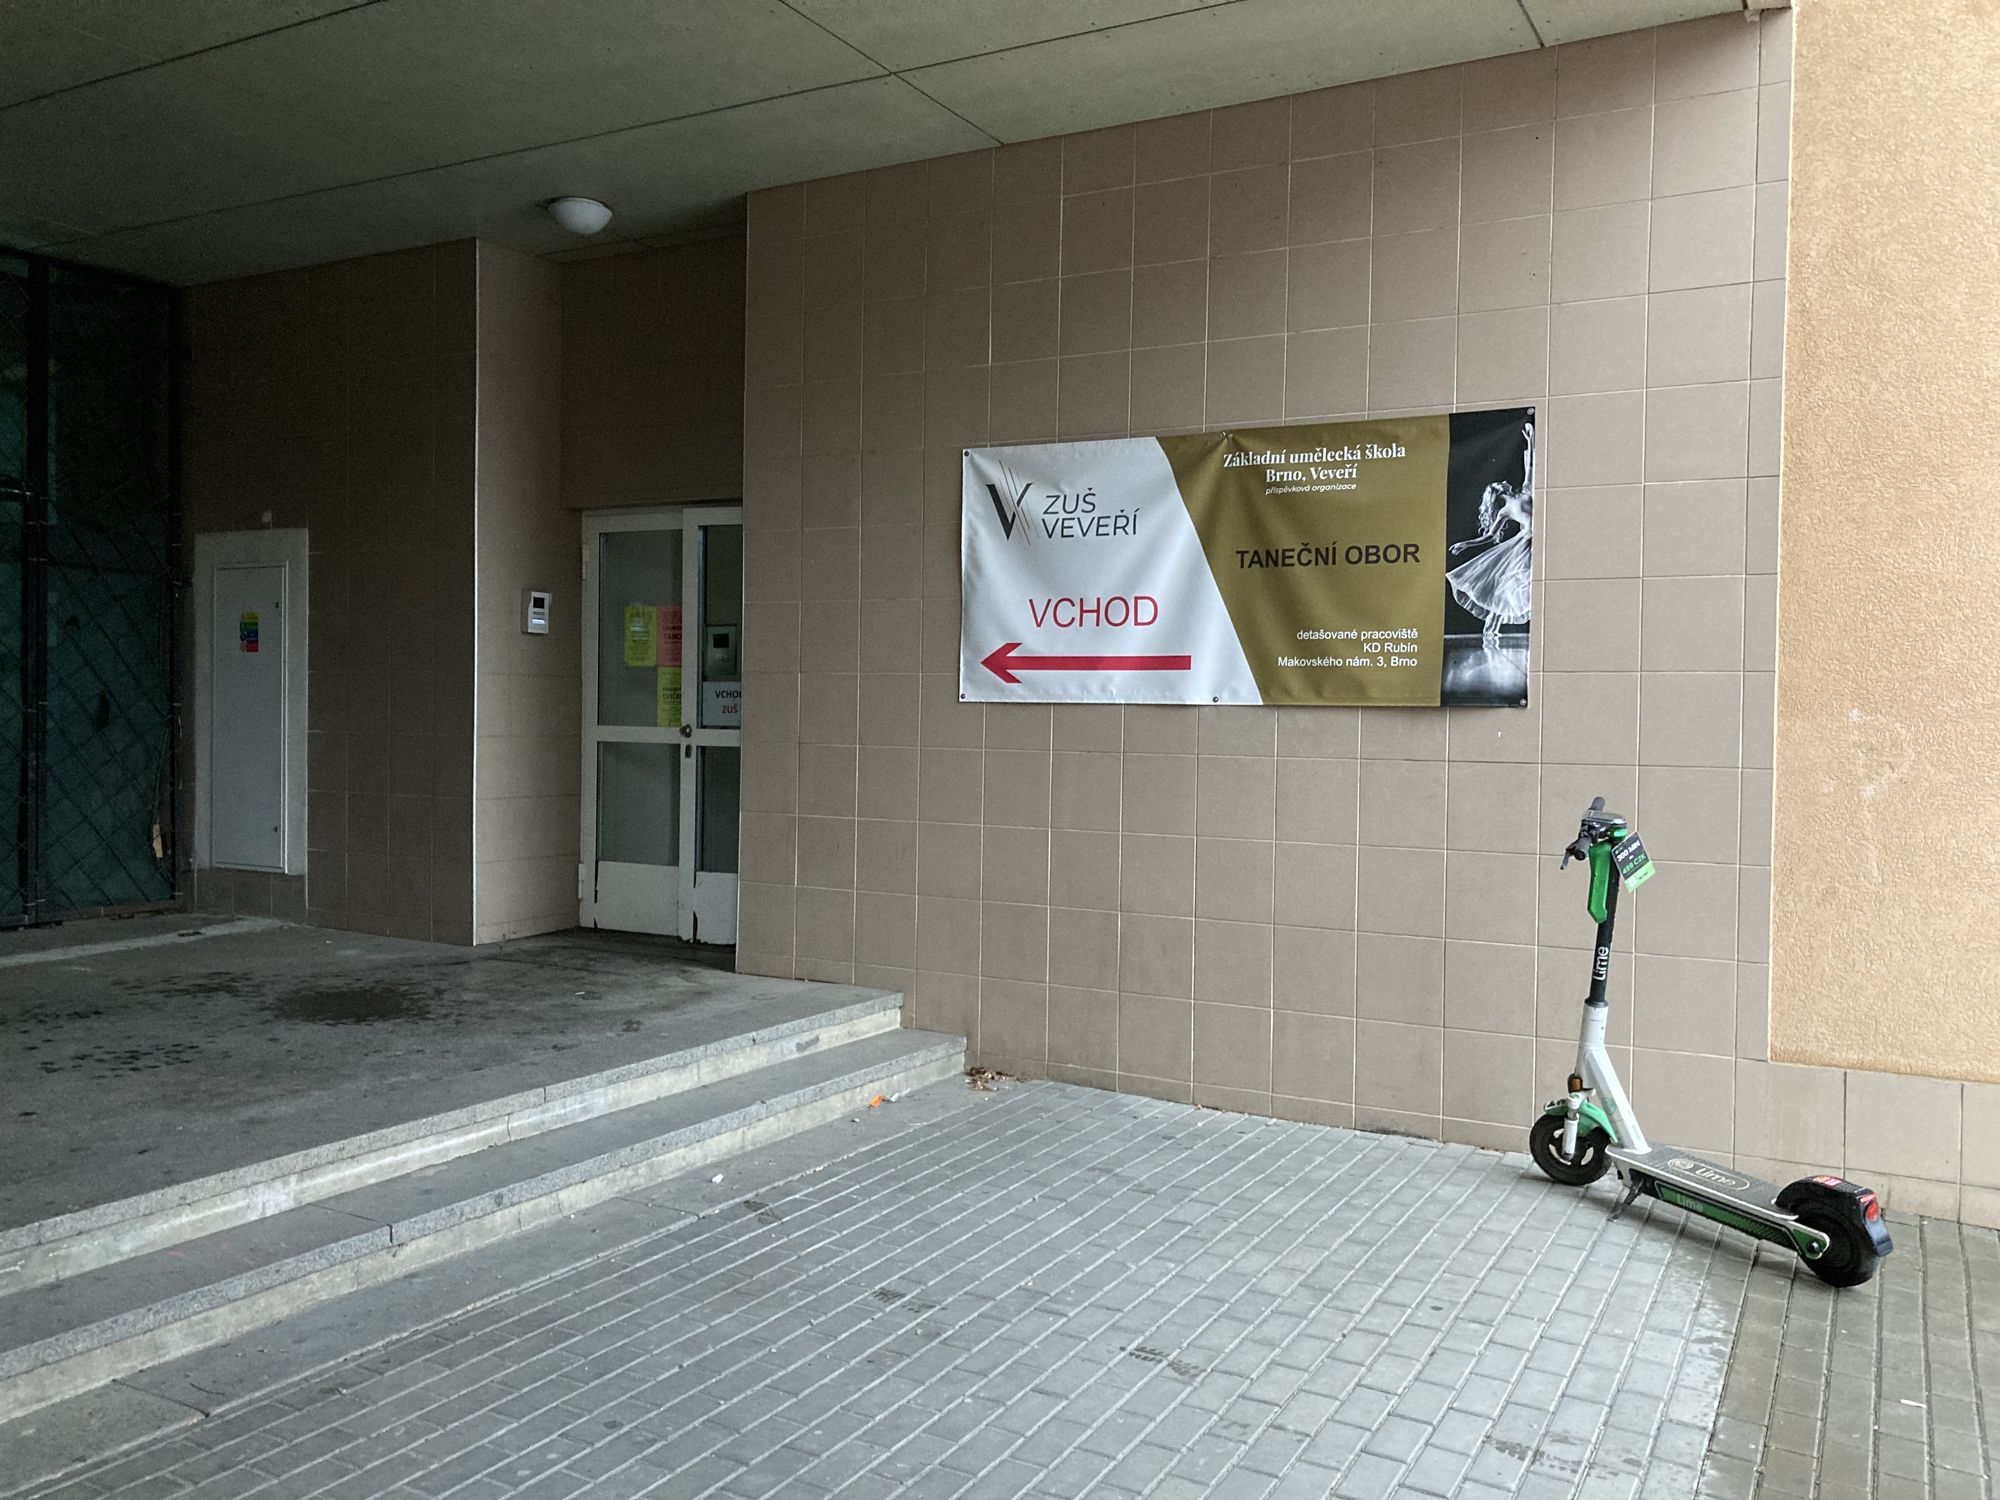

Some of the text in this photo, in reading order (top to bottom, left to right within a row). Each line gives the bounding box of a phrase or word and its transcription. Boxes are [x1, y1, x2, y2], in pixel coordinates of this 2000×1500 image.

[1223, 442, 1406, 468] Základní umělecká škola
[1265, 464, 1357, 483] Brno, Veveří
[1265, 482, 1357, 496] příspěvková organizace
[1043, 488, 1097, 515] ZUŠ
[1041, 508, 1144, 539] VEVEŘÍ
[1236, 541, 1420, 569] TANEČNÍ OBOR
[1028, 596, 1159, 628] VCHOD
[1297, 628, 1418, 641] detašované pracoviště
[1363, 642, 1418, 653] KD Rubín
[1277, 656, 1418, 668] Makovského nám. 3, Brno
[722, 704, 738, 714] ZUŠ
[1593, 946, 1609, 981] Lime
[1695, 1167, 1736, 1185] Lime
[1677, 1194, 1704, 1212] Lime
